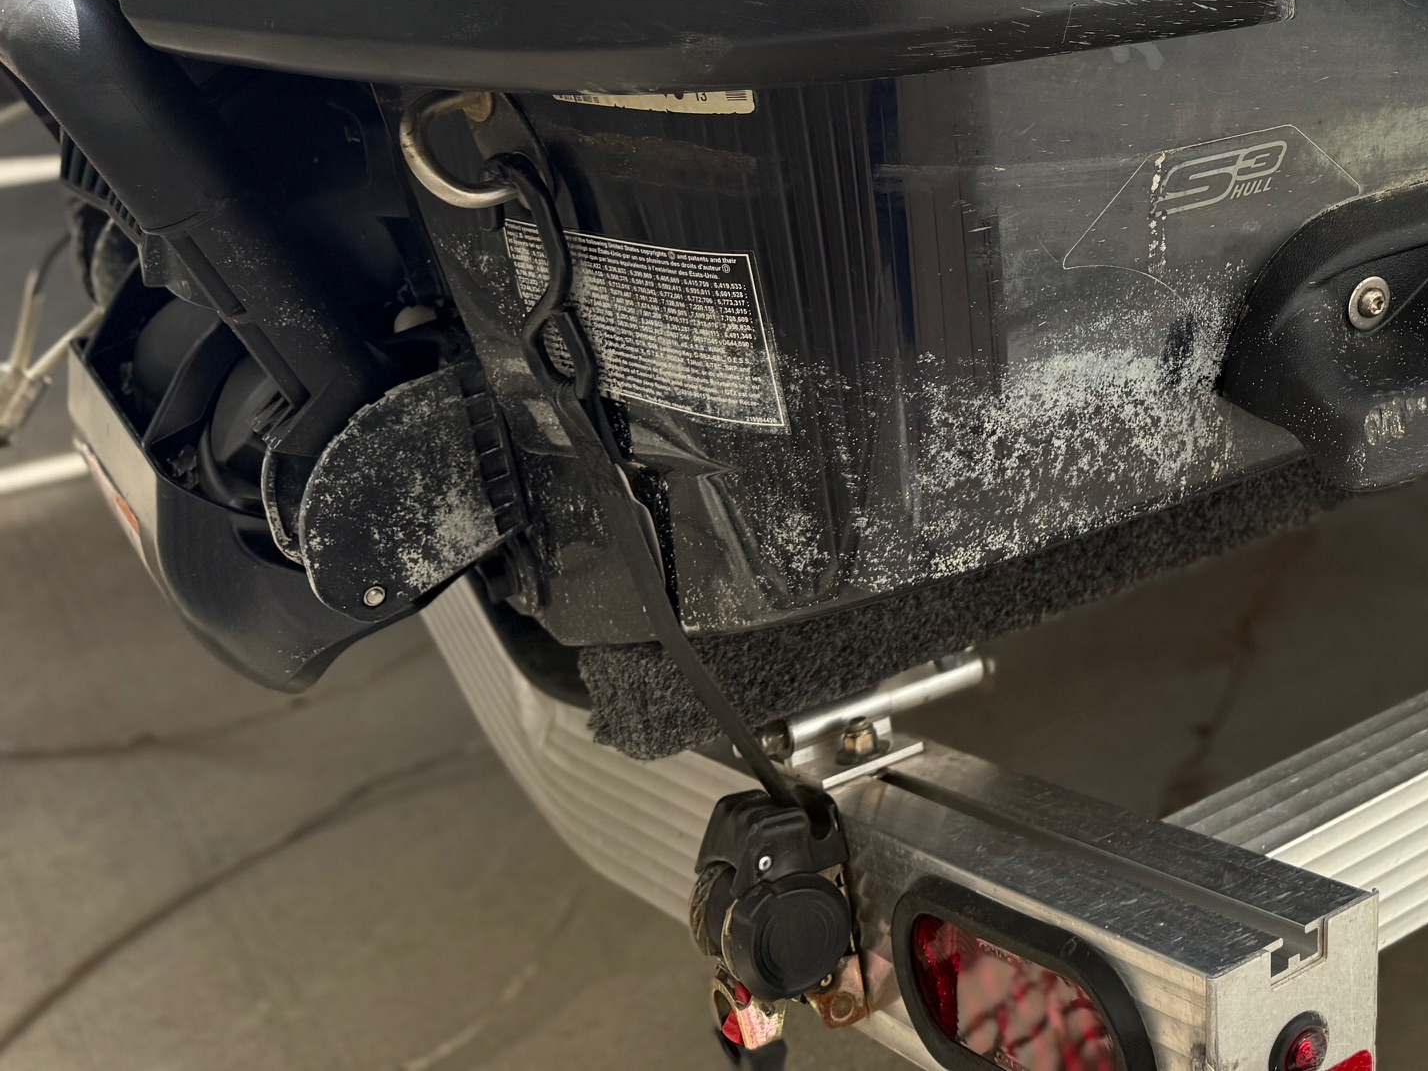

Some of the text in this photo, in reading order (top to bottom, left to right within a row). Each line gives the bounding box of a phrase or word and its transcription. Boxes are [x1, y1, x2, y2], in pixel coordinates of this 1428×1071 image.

[1150, 140, 1288, 217] S3
[1230, 177, 1272, 200] HULL
[640, 246, 667, 258] copyrights
[688, 255, 709, 263] patents
[681, 261, 697, 270] droits
